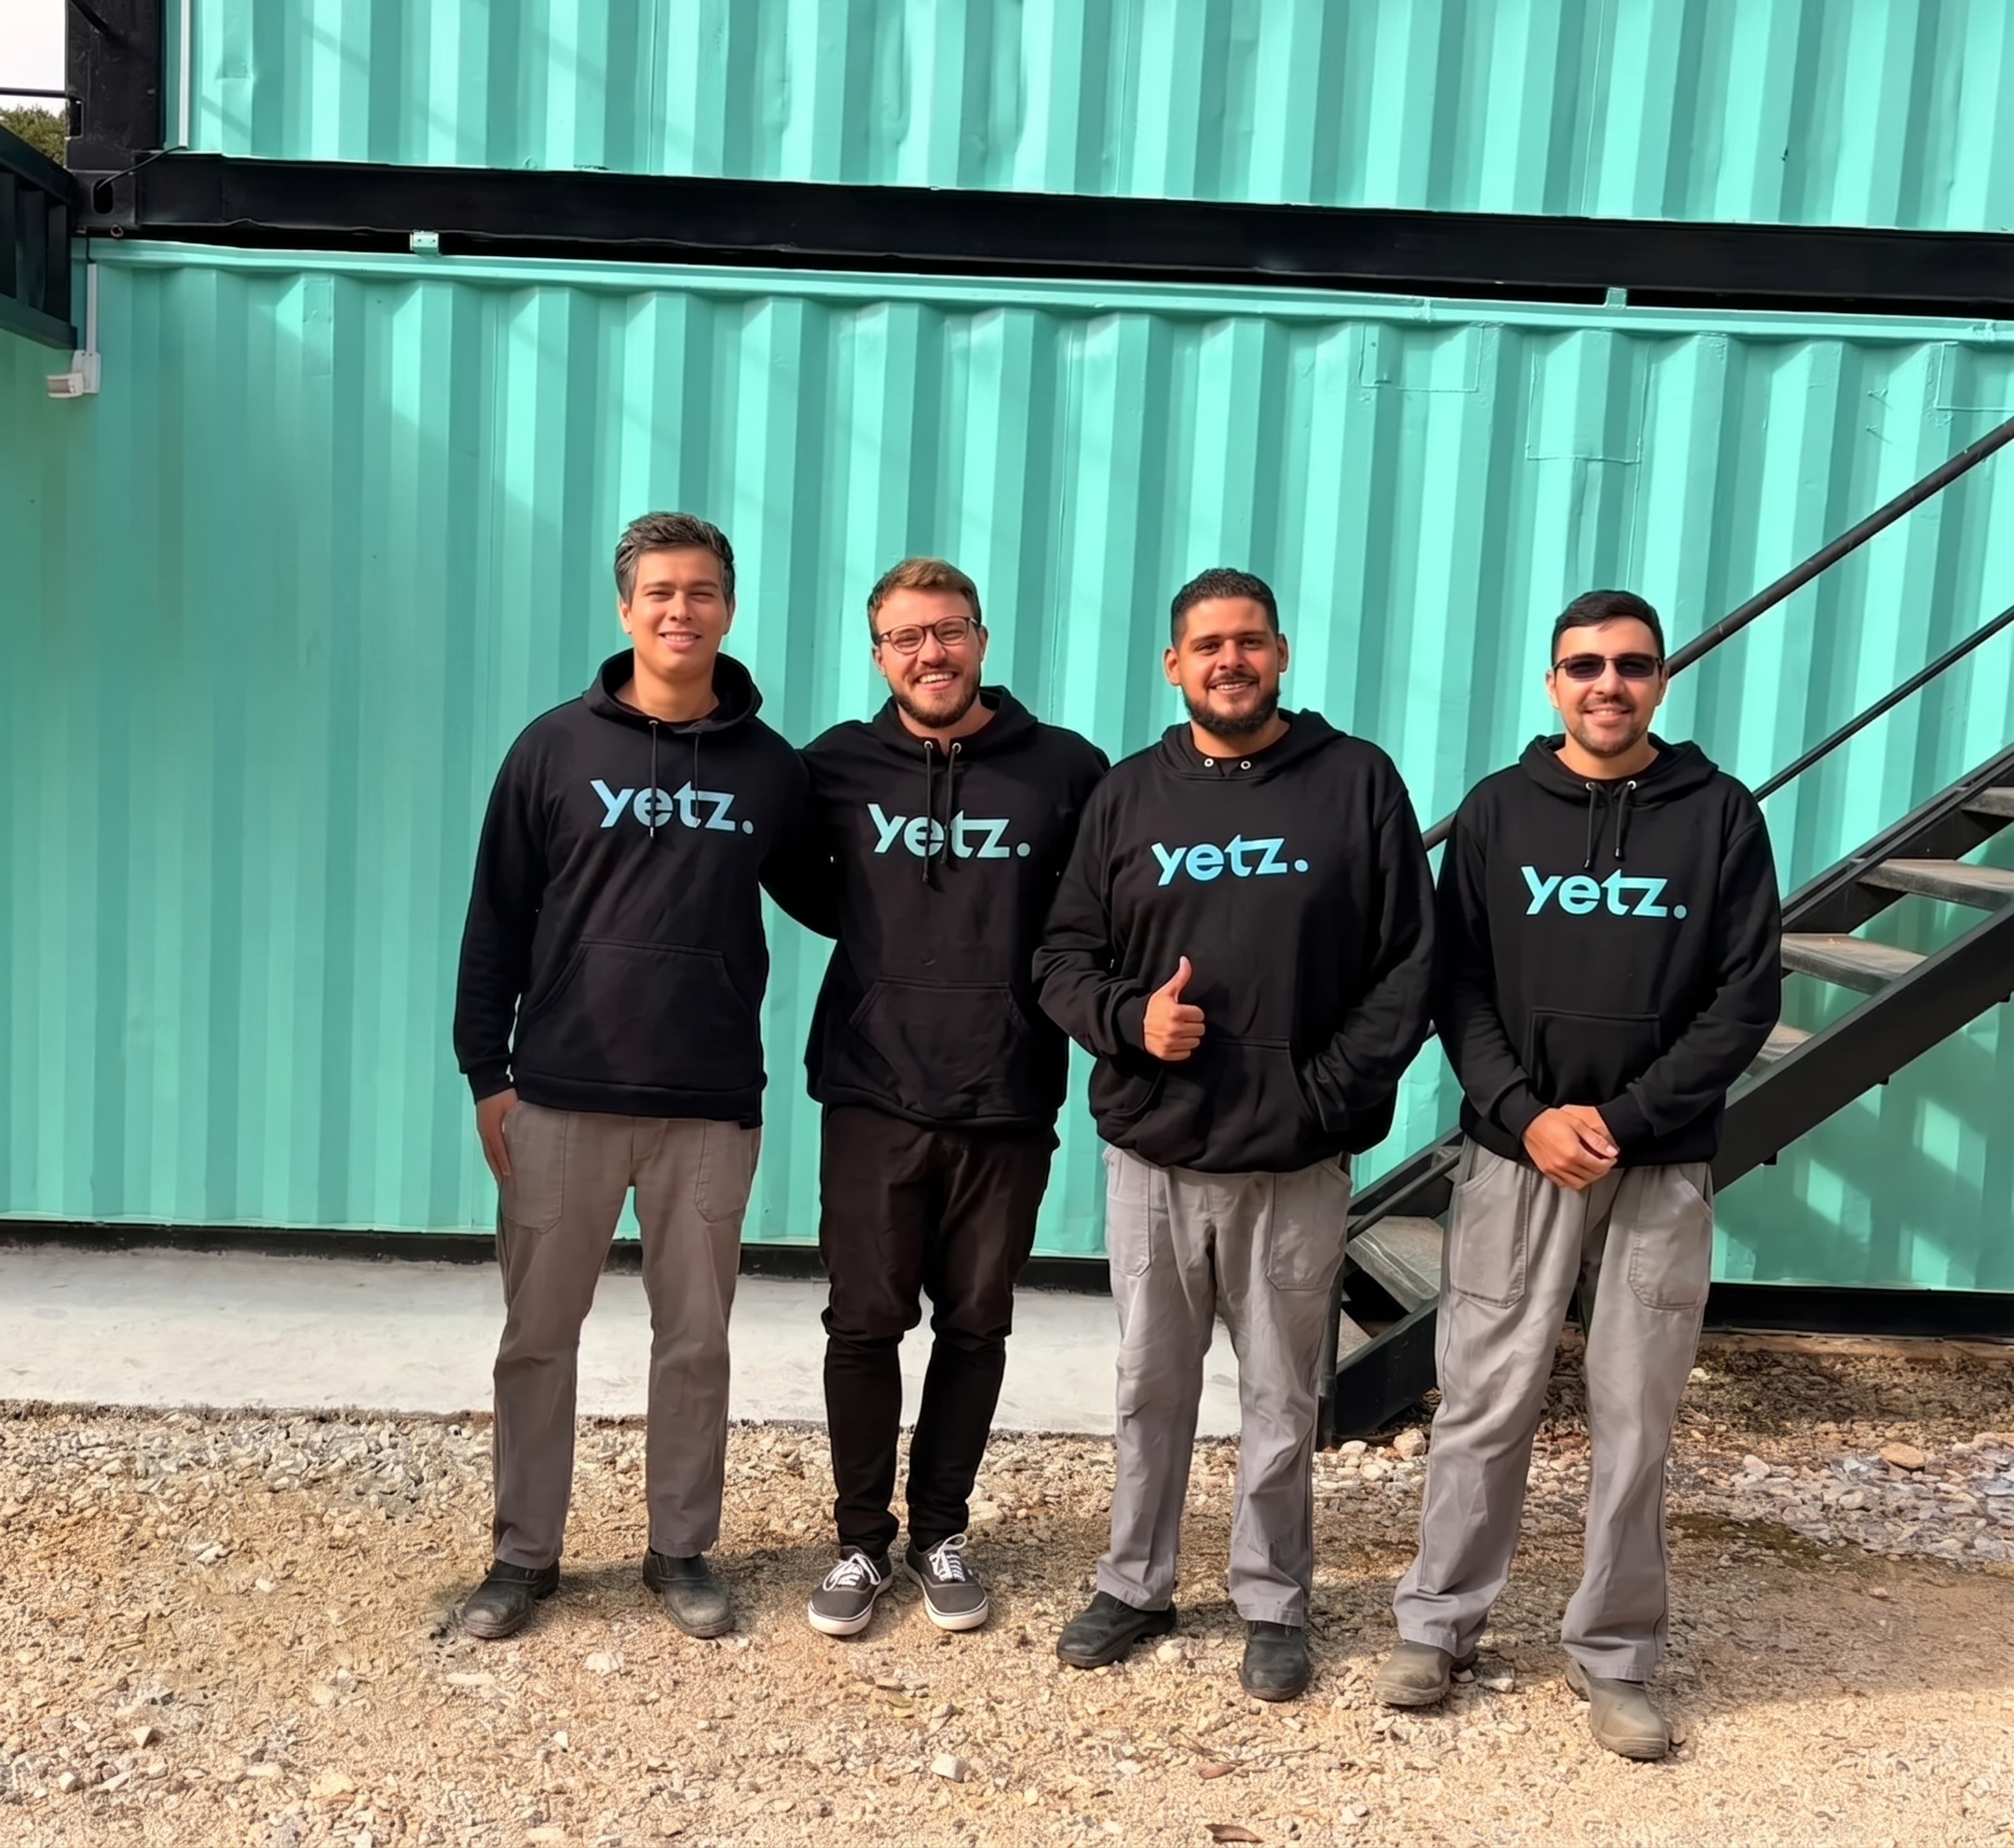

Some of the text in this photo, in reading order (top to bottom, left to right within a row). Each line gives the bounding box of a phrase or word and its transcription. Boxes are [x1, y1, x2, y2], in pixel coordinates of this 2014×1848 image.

[590, 778, 755, 835] yetz.
[866, 803, 1032, 859] yetz.
[1150, 834, 1310, 887] yetz.
[1520, 865, 1689, 920] yetz.
